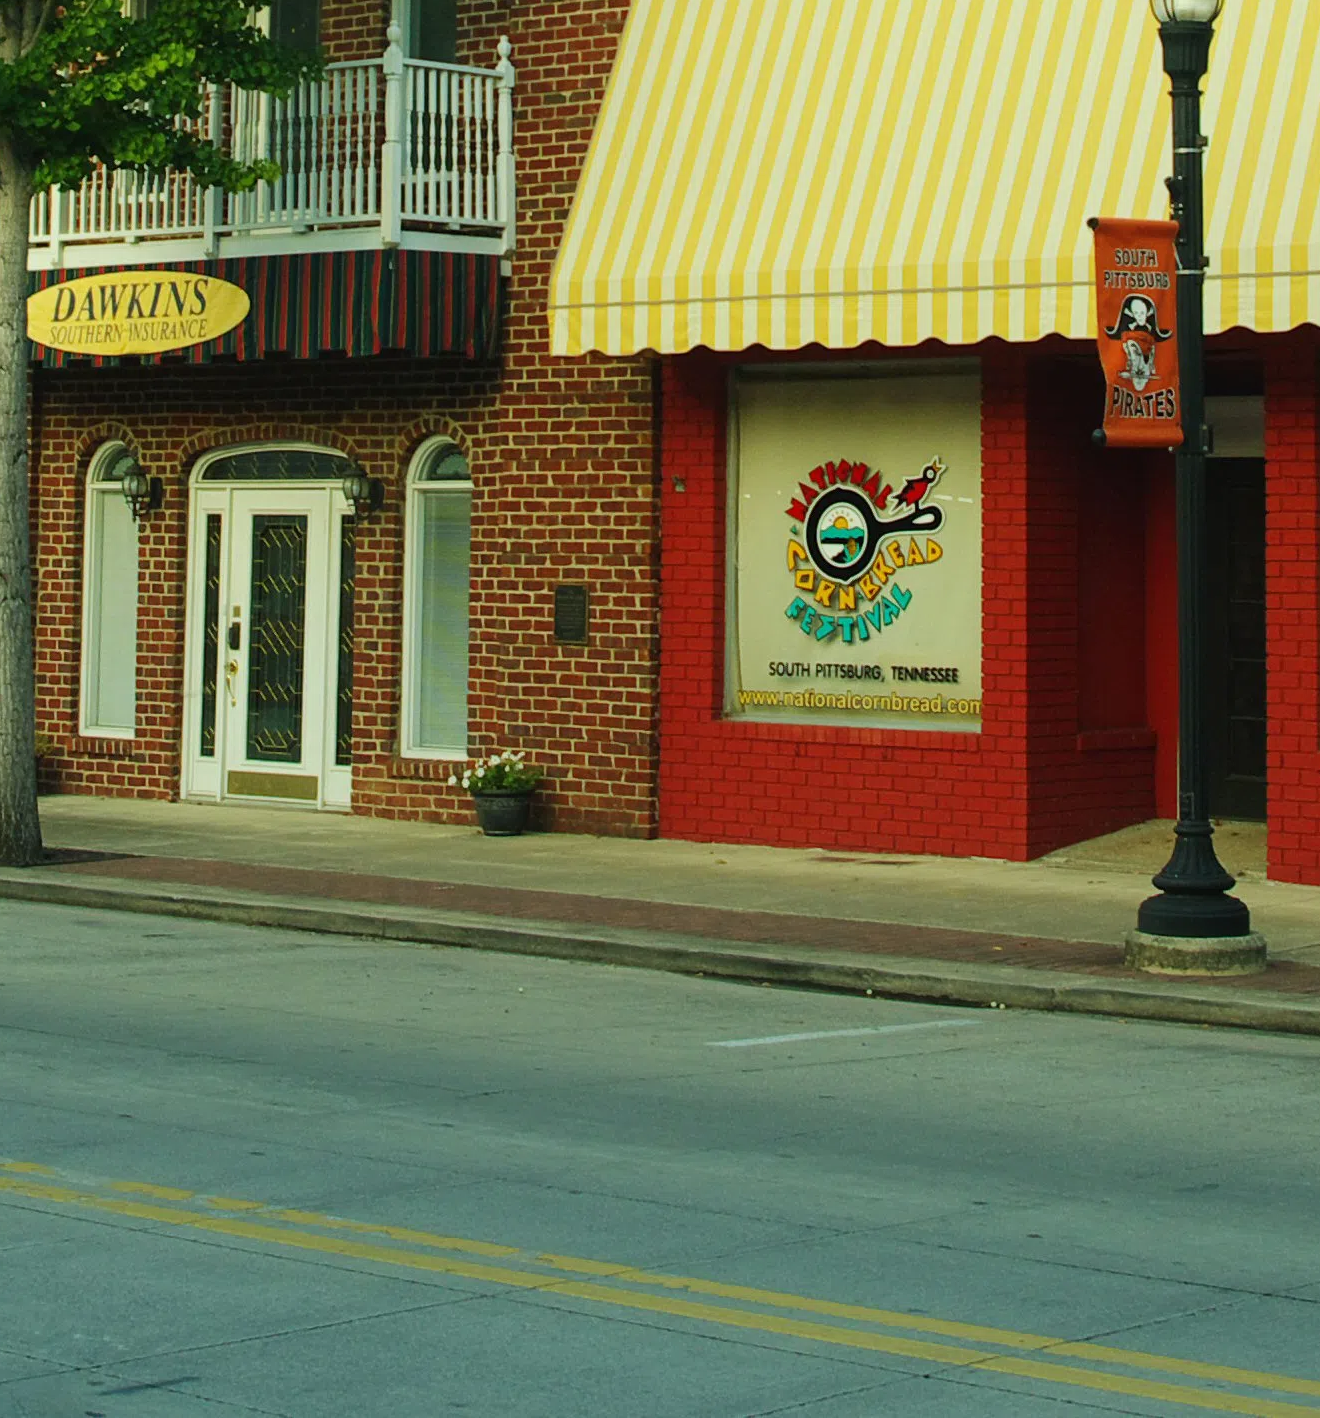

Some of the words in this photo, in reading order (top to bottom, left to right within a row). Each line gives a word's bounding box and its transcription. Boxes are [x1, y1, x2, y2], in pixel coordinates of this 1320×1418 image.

[1114, 248, 1159, 267] SOUTH
[1104, 271, 1170, 290] PITTSBURG
[51, 277, 209, 323] DAWKINS
[49, 322, 124, 346] SOUTHERN
[128, 317, 209, 342] INSURANCE
[1110, 386, 1177, 420] PIRATES
[784, 458, 894, 523] NATIONAL
[786, 537, 944, 611] CORNBREAD
[784, 582, 913, 643] FESTIVAL
[769, 661, 811, 678] SOUTH
[815, 662, 885, 683] PITTSBURG,
[891, 665, 960, 683] TENNESSEE
